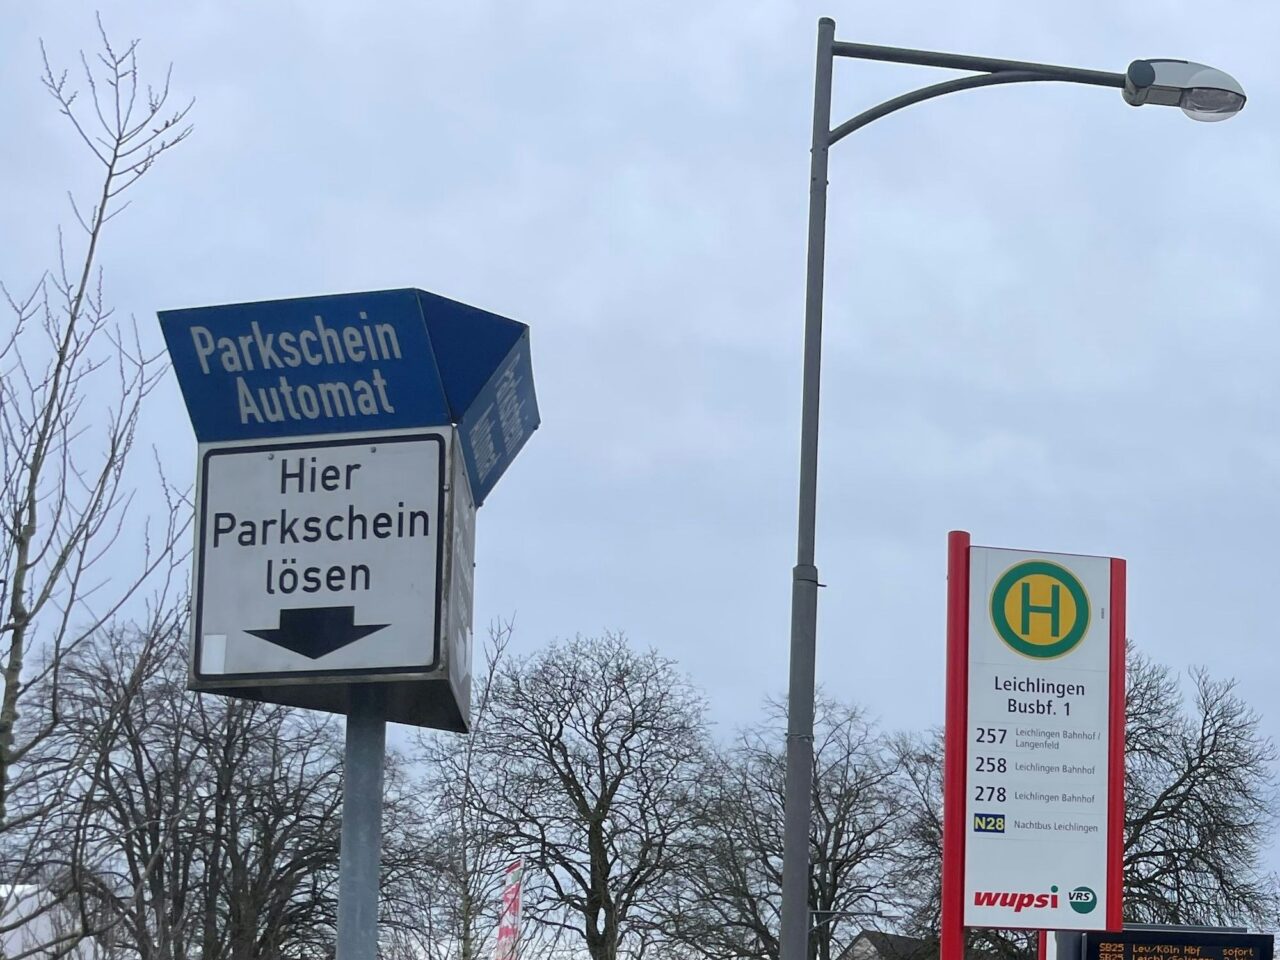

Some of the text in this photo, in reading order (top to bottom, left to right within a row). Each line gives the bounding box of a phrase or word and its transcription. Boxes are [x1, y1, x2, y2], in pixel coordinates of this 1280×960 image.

[190, 312, 402, 375] Parkschein
[235, 368, 396, 425] Automat
[280, 457, 362, 494] Hier
[212, 502, 430, 548] Parkschein
[266, 558, 371, 595] lösen
[1021, 582, 1060, 637] H
[995, 676, 1085, 698] Leichlingen
[1008, 699, 1070, 716] Busbf. 1
[976, 727, 1007, 744] 257
[1015, 728, 1060, 739] Leichlingen
[1062, 730, 1096, 740] Bahnhof
[1015, 739, 1060, 750] Langenfeld
[975, 756, 1096, 774] 258 Leichlingen Bahnhof
[974, 786, 1095, 803] 278 Leichlingen Bahnhof
[974, 816, 1098, 833] N28 Nachtbus Leichlingen
[974, 885, 1090, 912] wupsi VRS
[1099, 943, 1124, 952] SB25
[1184, 945, 1202, 956] Hbf
[1222, 947, 1254, 957] sofort
